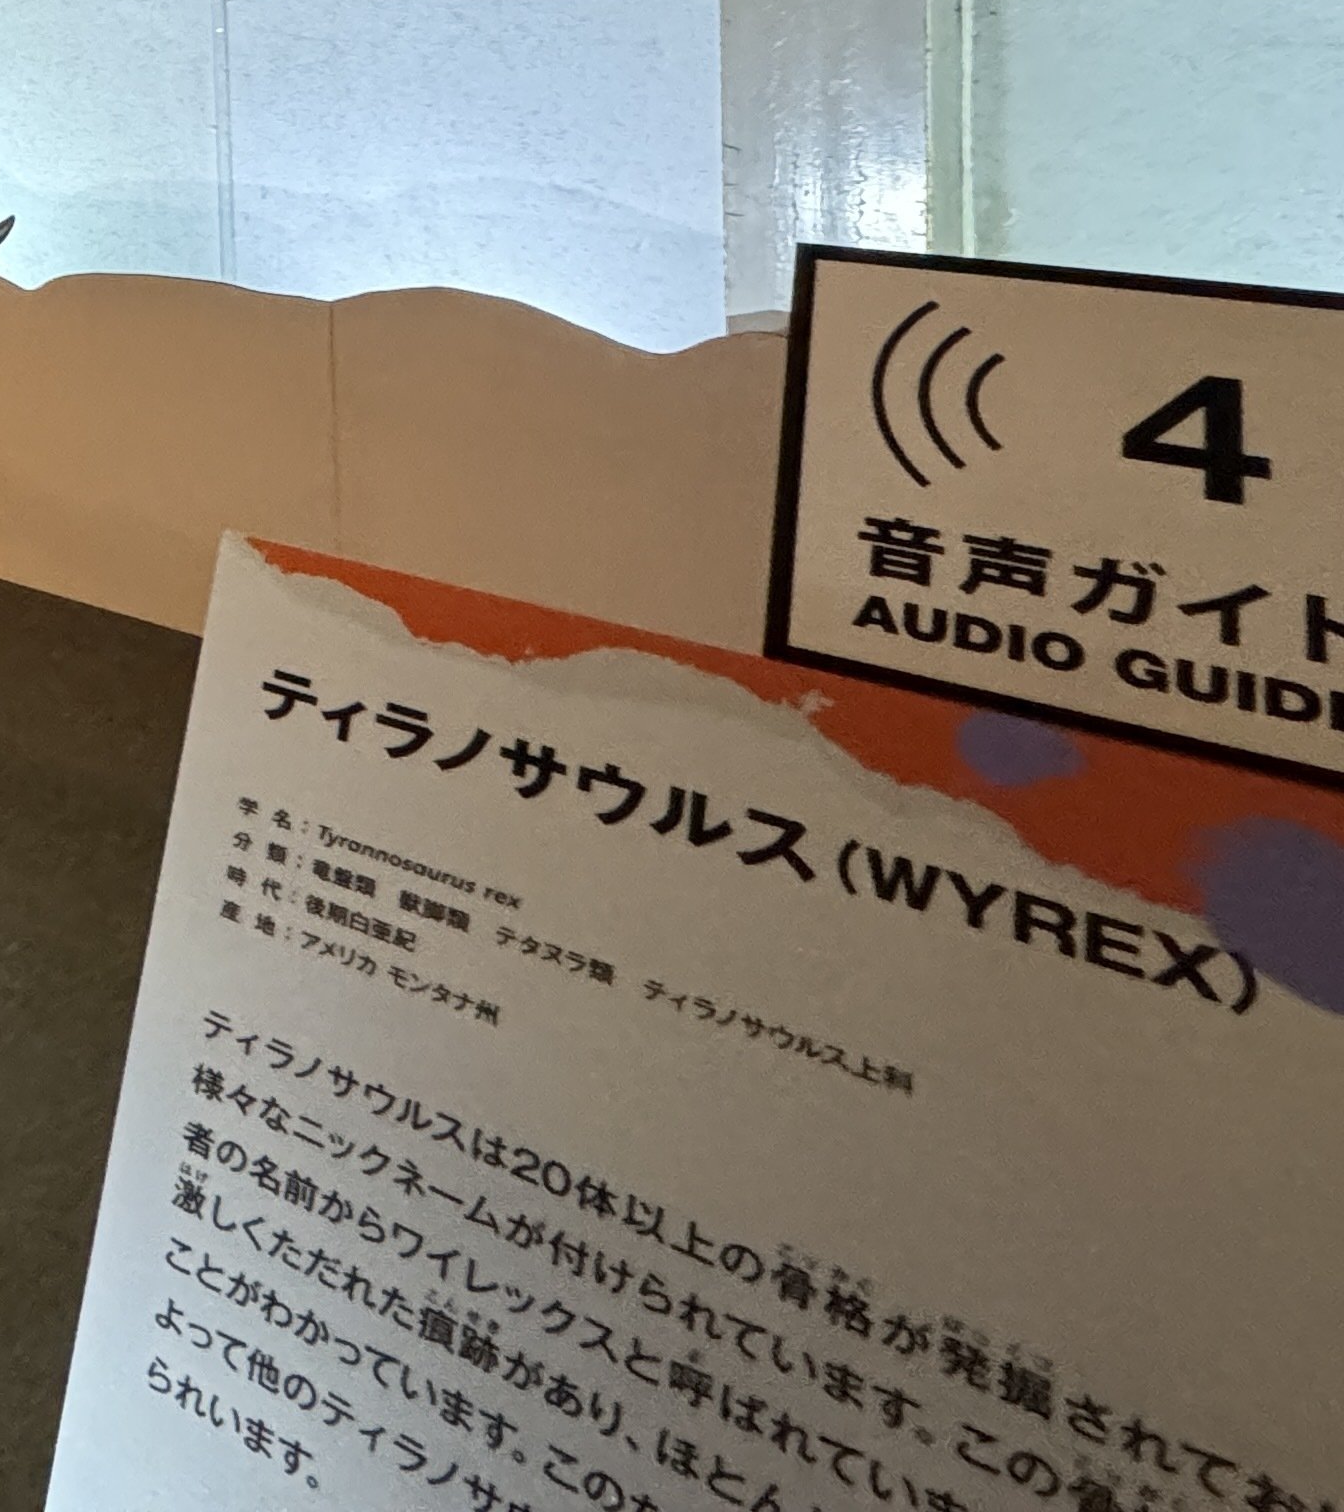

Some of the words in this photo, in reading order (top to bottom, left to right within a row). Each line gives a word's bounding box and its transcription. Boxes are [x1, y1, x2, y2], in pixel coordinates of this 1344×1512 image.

[1123, 375, 1272, 504] 4
[852, 595, 1086, 673] AUDIO
[318, 824, 476, 894] Tyrannosaurus
[483, 886, 523, 910] rex
[154, 1297, 531, 1512] よって他のティラノサ
